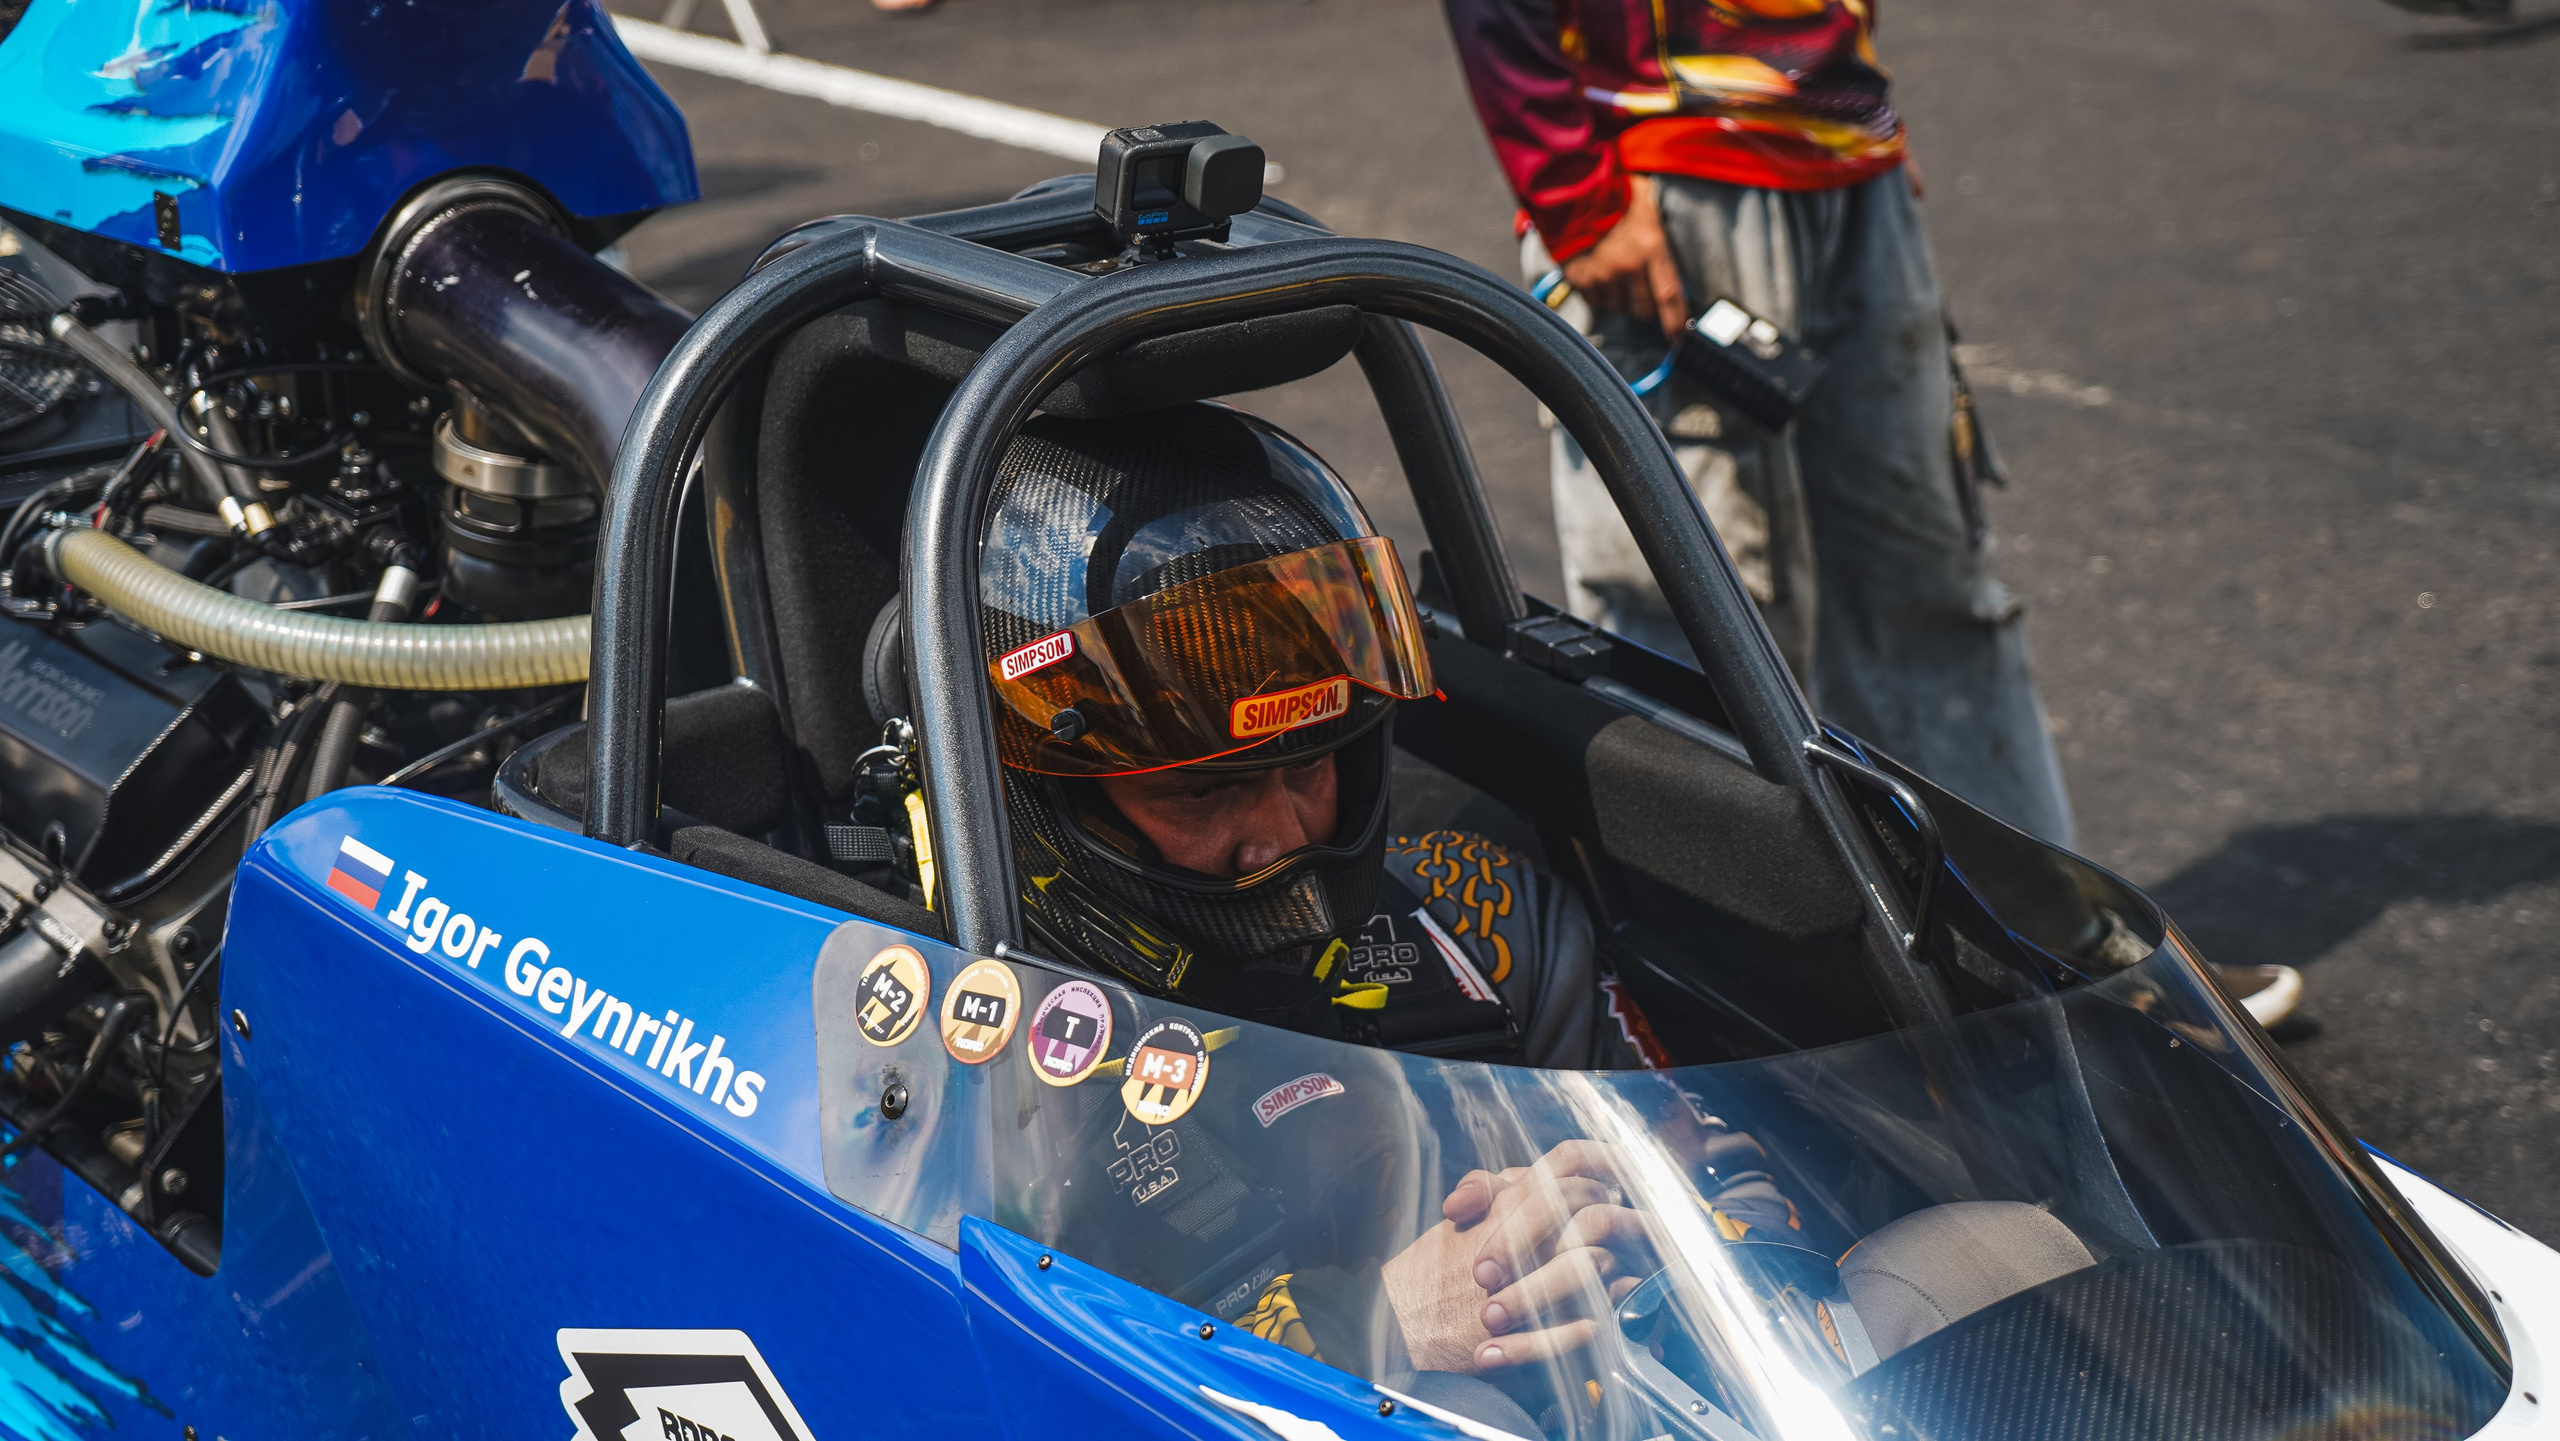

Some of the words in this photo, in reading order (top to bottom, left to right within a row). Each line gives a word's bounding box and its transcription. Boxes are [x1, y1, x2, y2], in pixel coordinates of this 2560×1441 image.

[1138, 211, 1169, 219] GoPro
[1007, 637, 1066, 676] SIMPSON
[1242, 688, 1339, 731] SIMPSON
[1347, 942, 1420, 972] PRO
[387, 870, 502, 969] Igor
[504, 937, 767, 1118] Geynrikhs
[1125, 1022, 1165, 1076] МЕДИЦИНСКИЙ
[1169, 1022, 1200, 1047] КОНТРОЛЬ
[1260, 1075, 1333, 1117] SIMPSON
[1107, 1128, 1181, 1194] PRO
[1215, 1282, 1250, 1315] PRO
